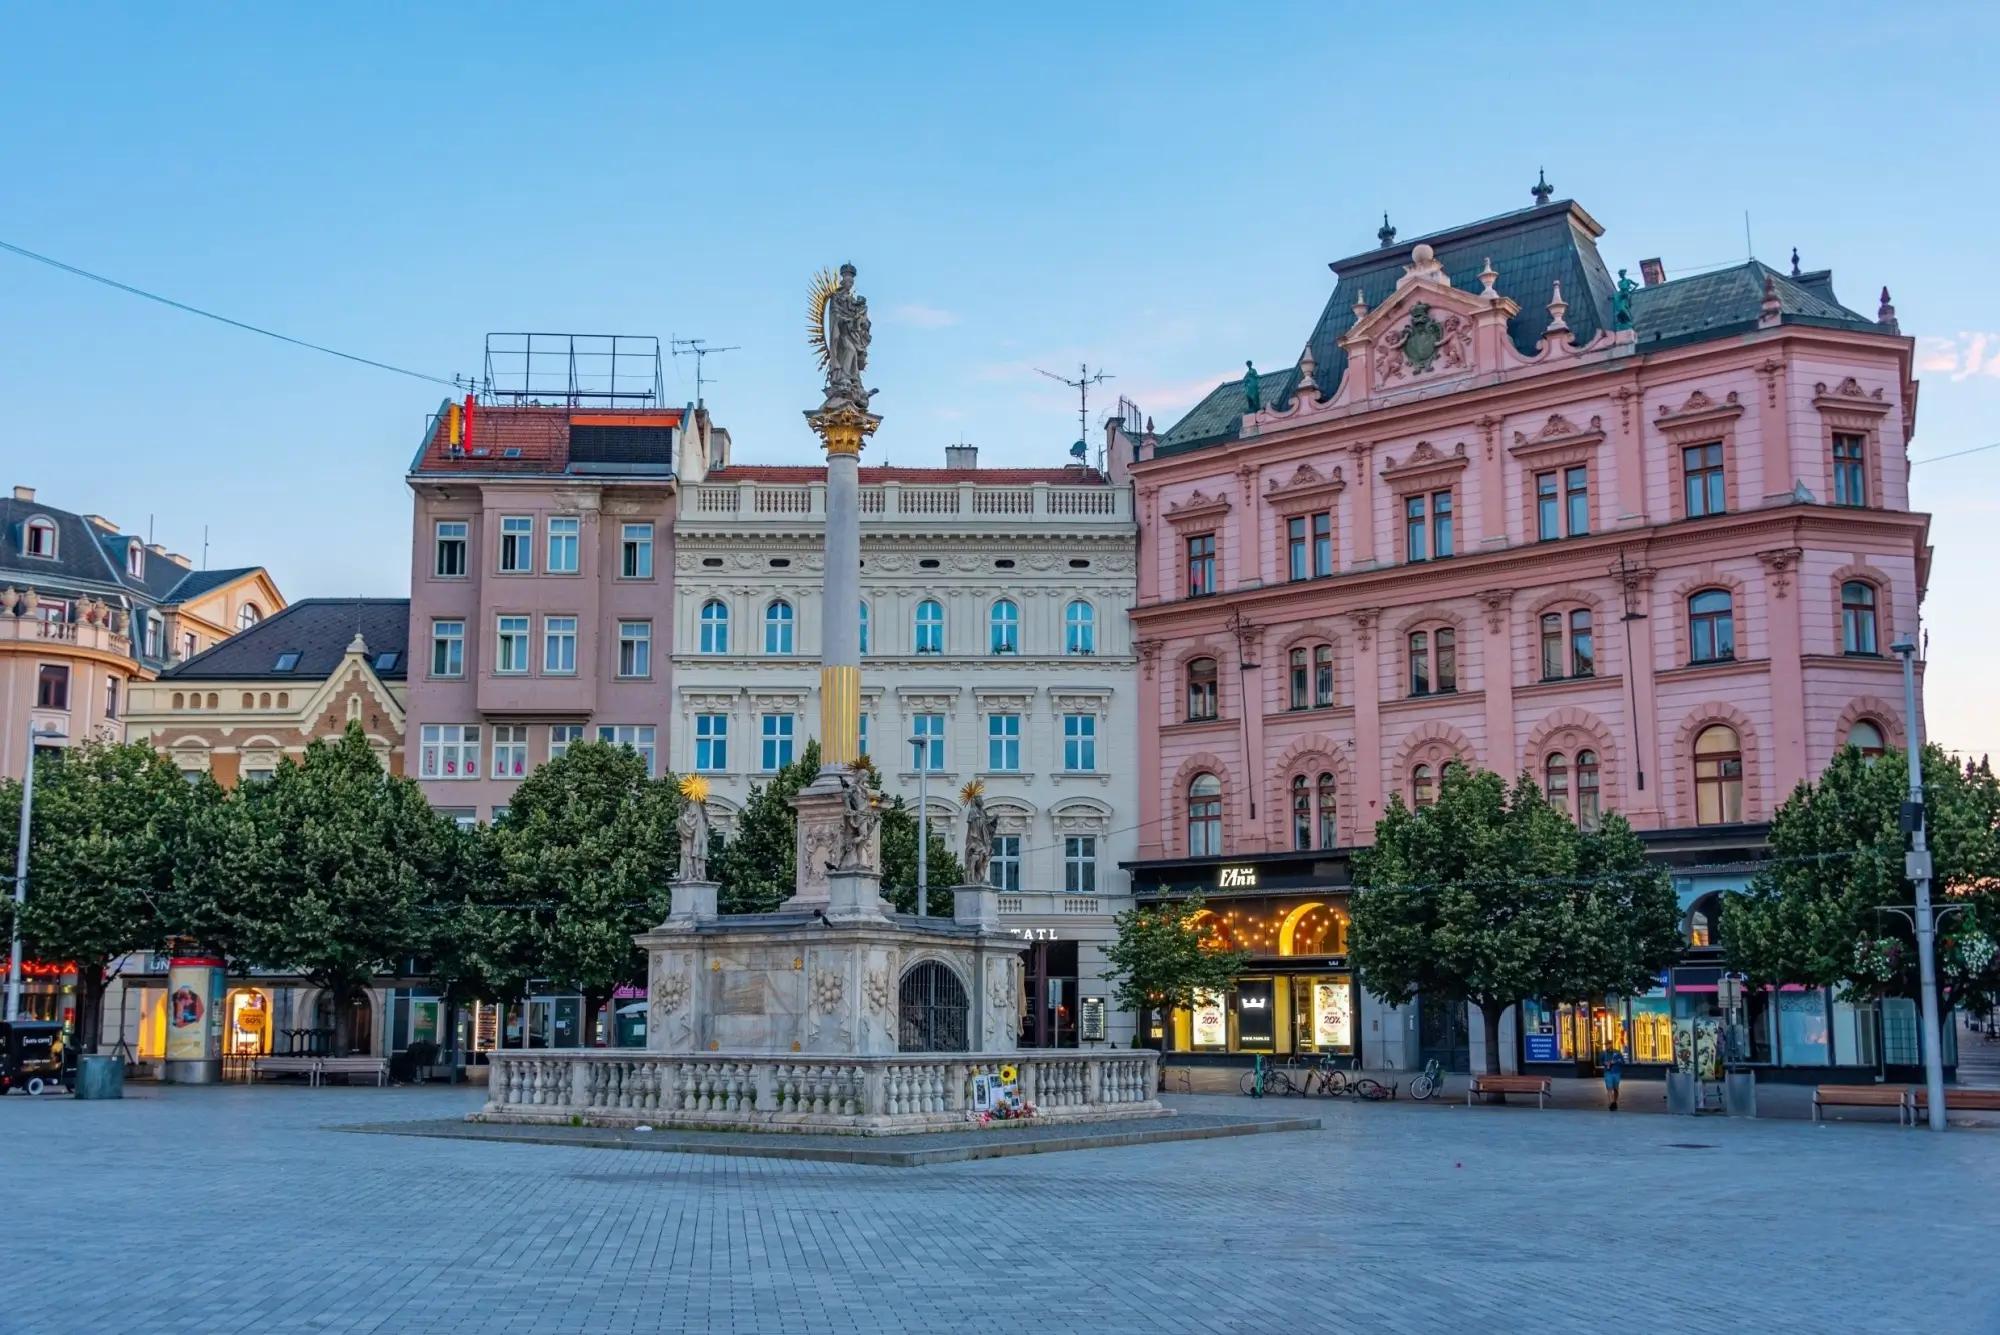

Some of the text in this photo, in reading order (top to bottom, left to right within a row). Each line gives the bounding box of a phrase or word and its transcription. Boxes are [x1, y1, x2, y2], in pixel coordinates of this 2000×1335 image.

[447, 761, 523, 773] SOLA
[1202, 1016, 1218, 1024] 20%
[1324, 1015, 1341, 1024] 20%
